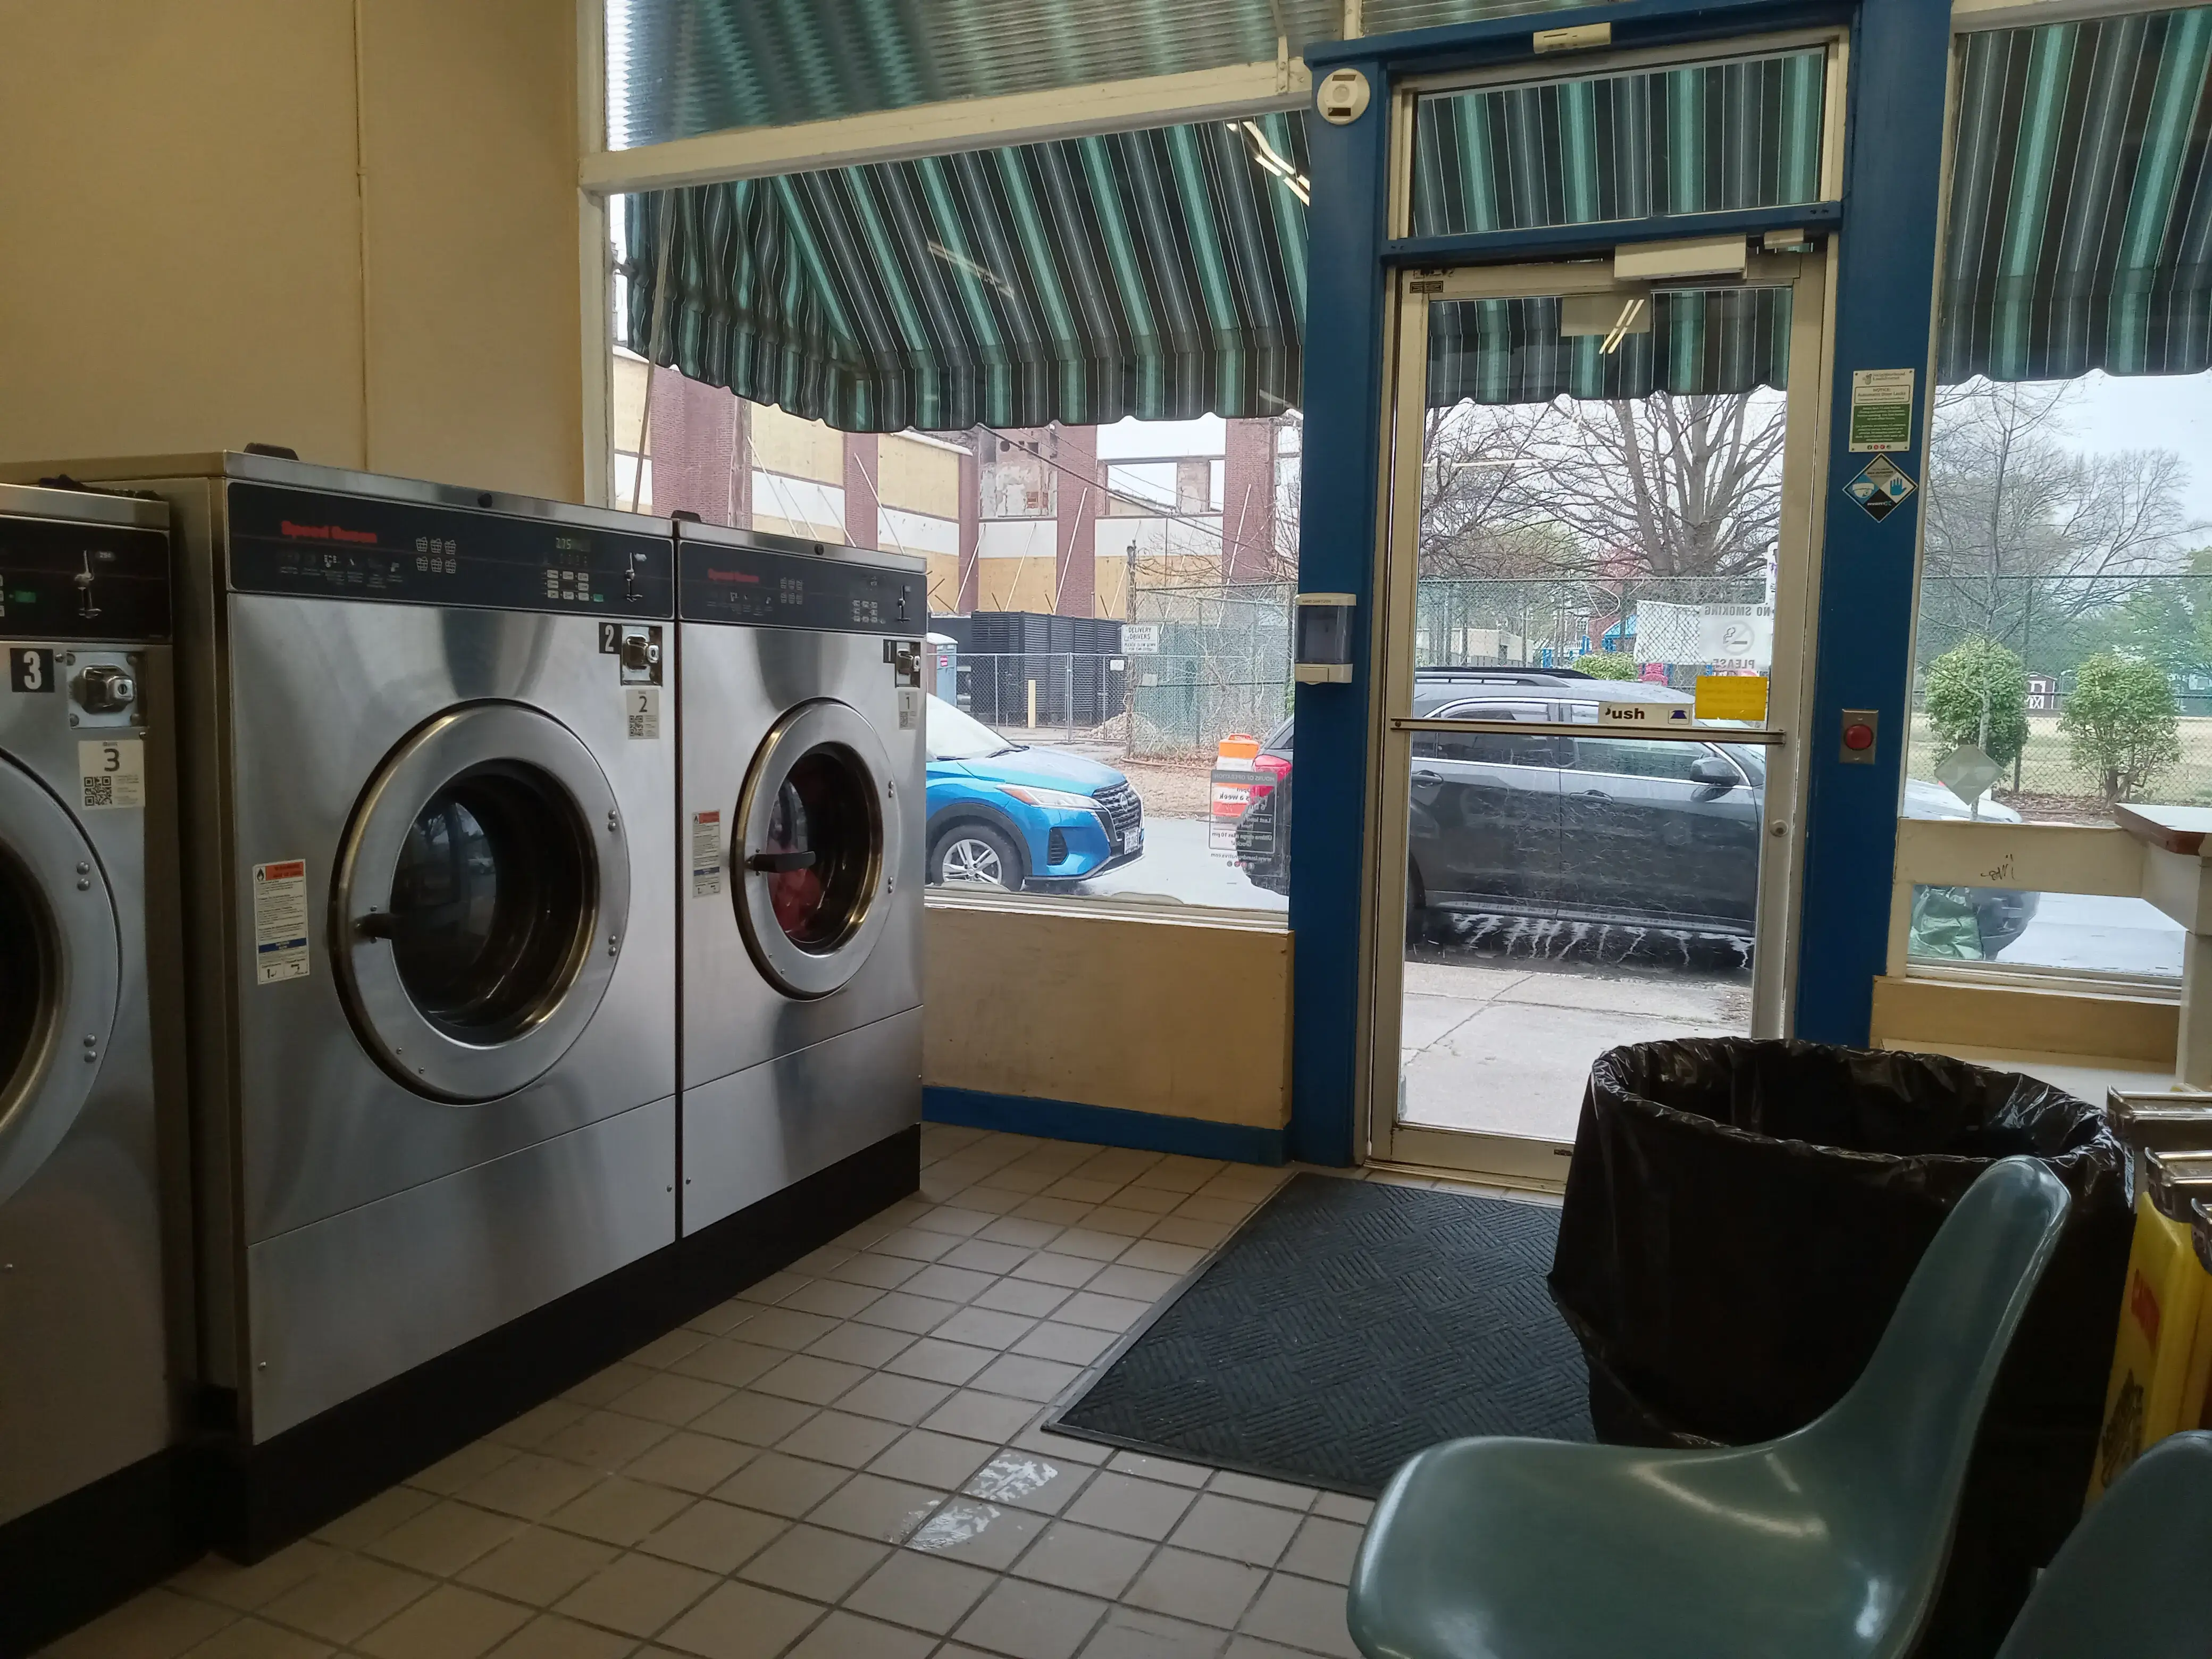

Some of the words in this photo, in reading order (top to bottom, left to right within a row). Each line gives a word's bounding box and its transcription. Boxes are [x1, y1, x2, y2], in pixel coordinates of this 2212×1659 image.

[605, 625, 614, 652] 2
[23, 650, 43, 690] 3
[638, 696, 648, 713] 2
[906, 696, 910, 710] 1
[103, 748, 121, 772] 3
